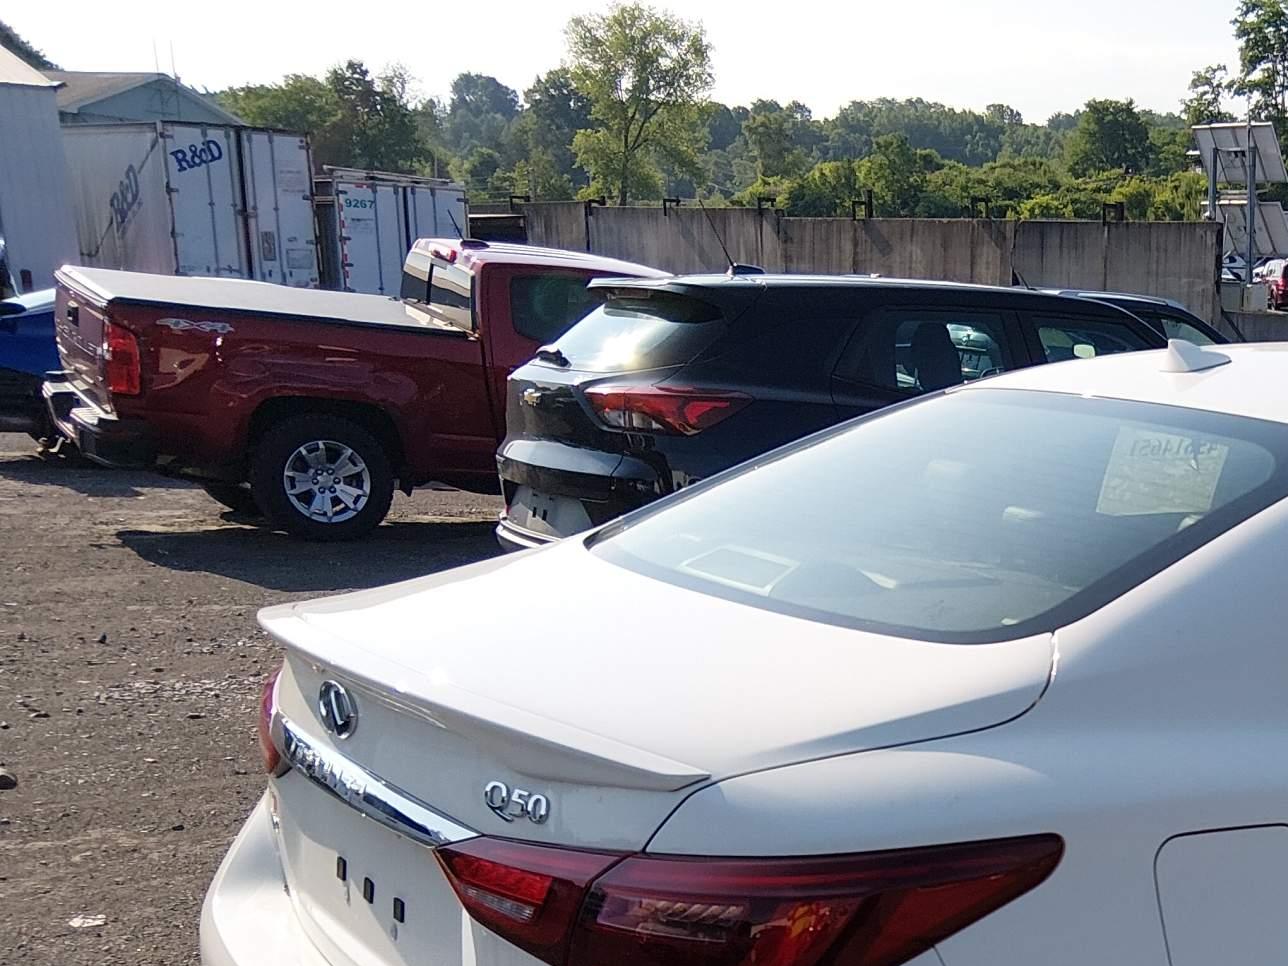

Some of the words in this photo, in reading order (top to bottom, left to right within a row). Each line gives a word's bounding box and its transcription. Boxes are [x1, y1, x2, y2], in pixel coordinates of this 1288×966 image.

[170, 139, 223, 173] R&D
[344, 198, 375, 209] 9267
[484, 780, 549, 825] Q50
